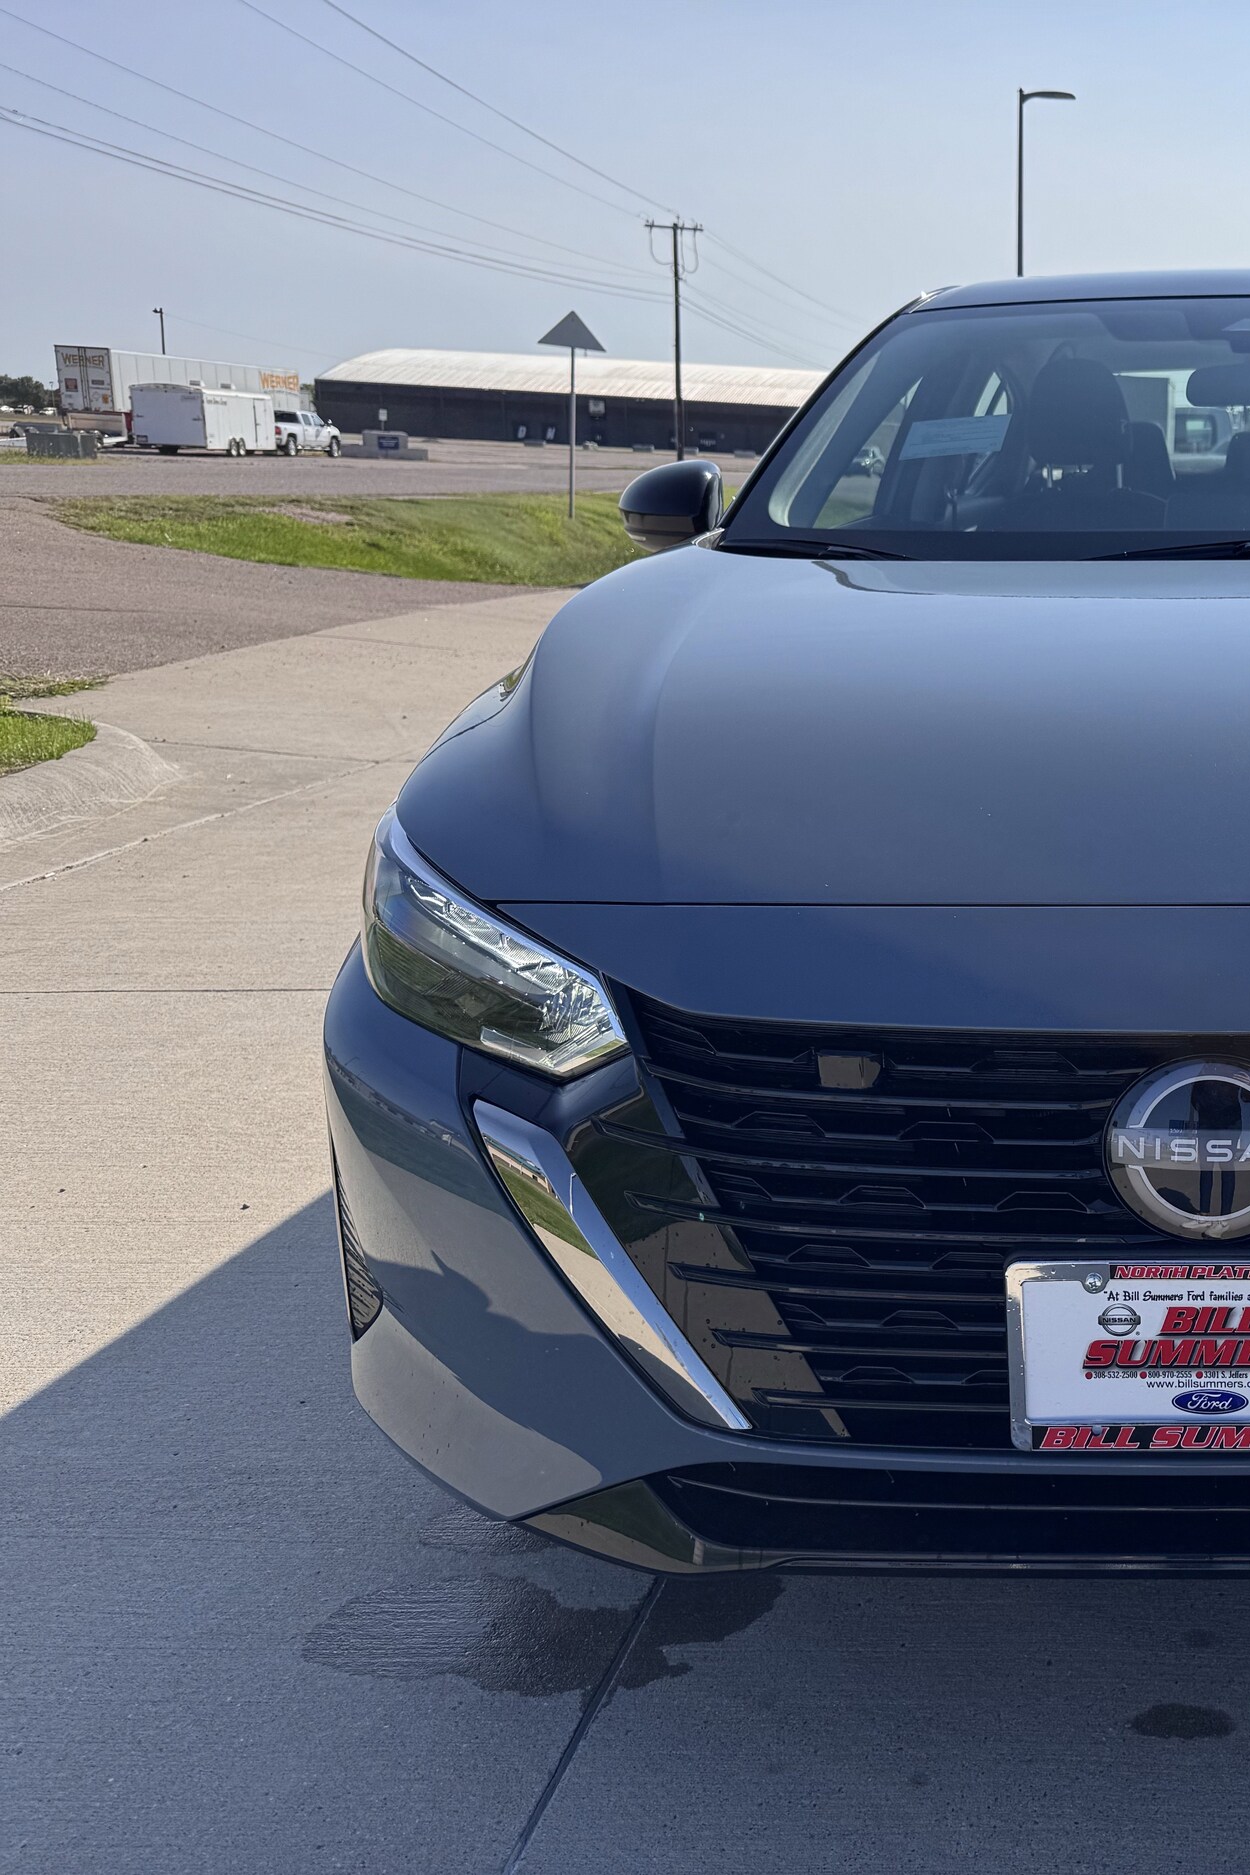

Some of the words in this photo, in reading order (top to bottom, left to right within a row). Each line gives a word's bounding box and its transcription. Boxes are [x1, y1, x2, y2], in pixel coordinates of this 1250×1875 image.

[61, 352, 105, 367] WERNER
[258, 370, 299, 392] WERNER
[1114, 1265, 1189, 1279] NORTH
[1123, 1290, 1140, 1301] Bill
[1142, 1290, 1183, 1301] Summers
[1187, 1290, 1205, 1301] Ford
[1209, 1291, 1243, 1301] families
[1093, 1370, 1138, 1379] 308-532-2500
[1147, 1370, 1192, 1379] 800-970-2555
[1203, 1370, 1219, 1379] 3301
[1221, 1370, 1228, 1379] S.
[1228, 1370, 1248, 1379] Jeffers
[1187, 1392, 1233, 1411] Ford
[1039, 1426, 1141, 1449] BILL
